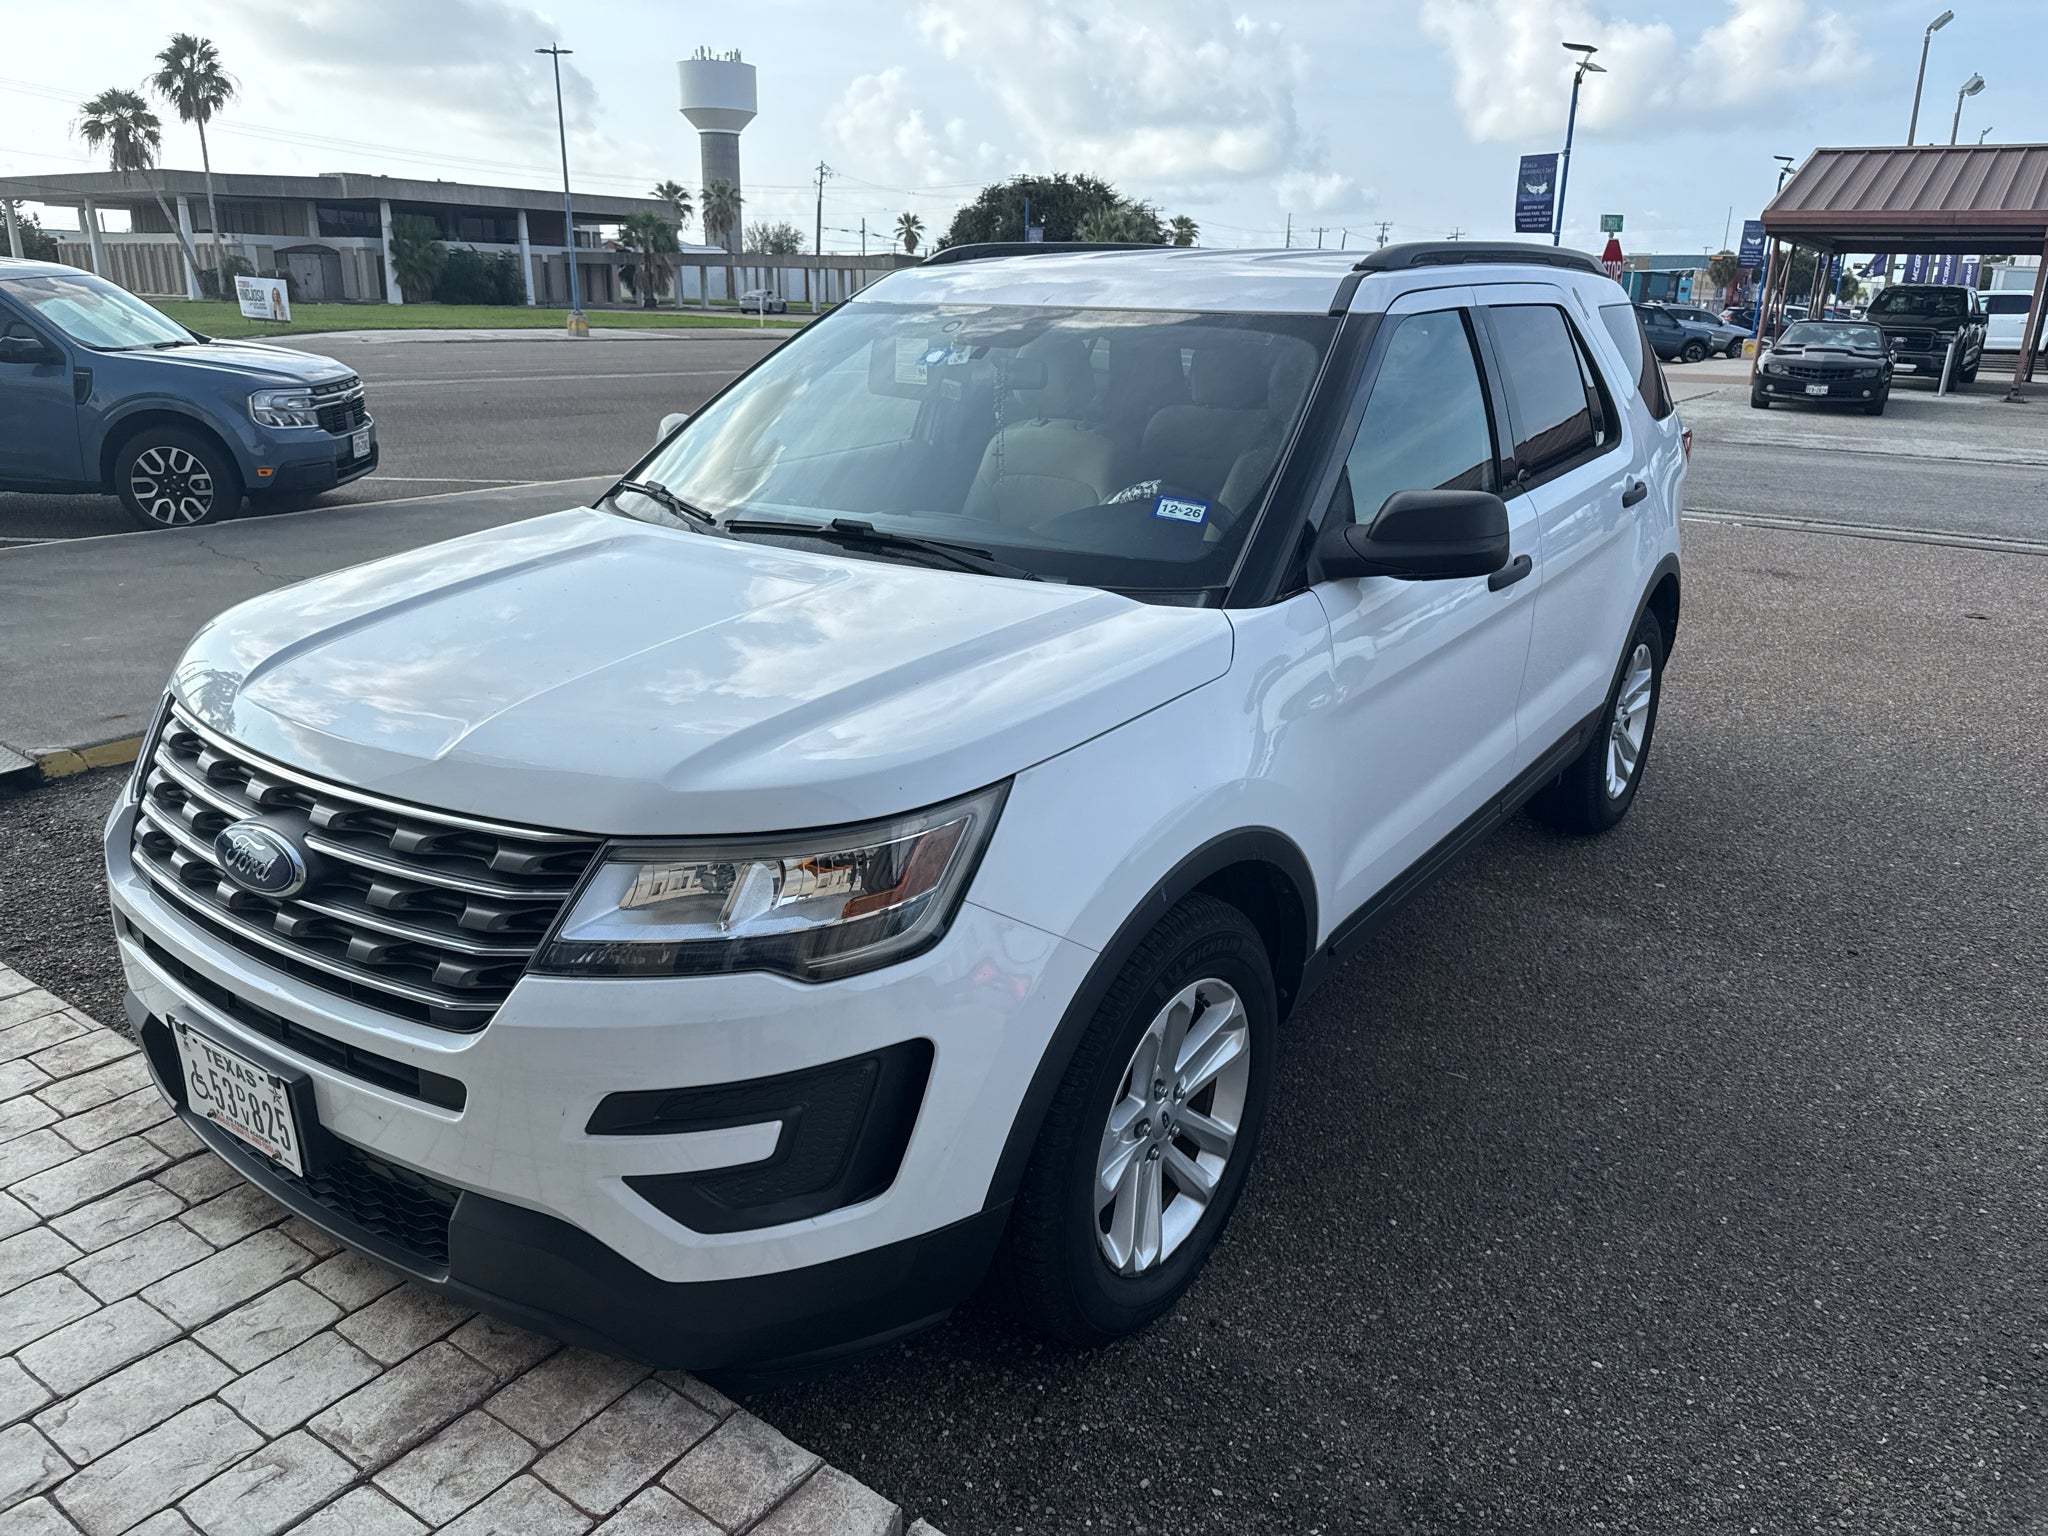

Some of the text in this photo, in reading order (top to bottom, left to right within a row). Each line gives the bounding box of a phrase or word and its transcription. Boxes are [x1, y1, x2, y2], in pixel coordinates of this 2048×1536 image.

[1911, 254, 1922, 281] MCGR
[1162, 504, 1202, 518] 12 26
[225, 834, 275, 882] Ford
[1184, 938, 1241, 970] MICHELIN
[201, 1044, 257, 1088] TEXAS
